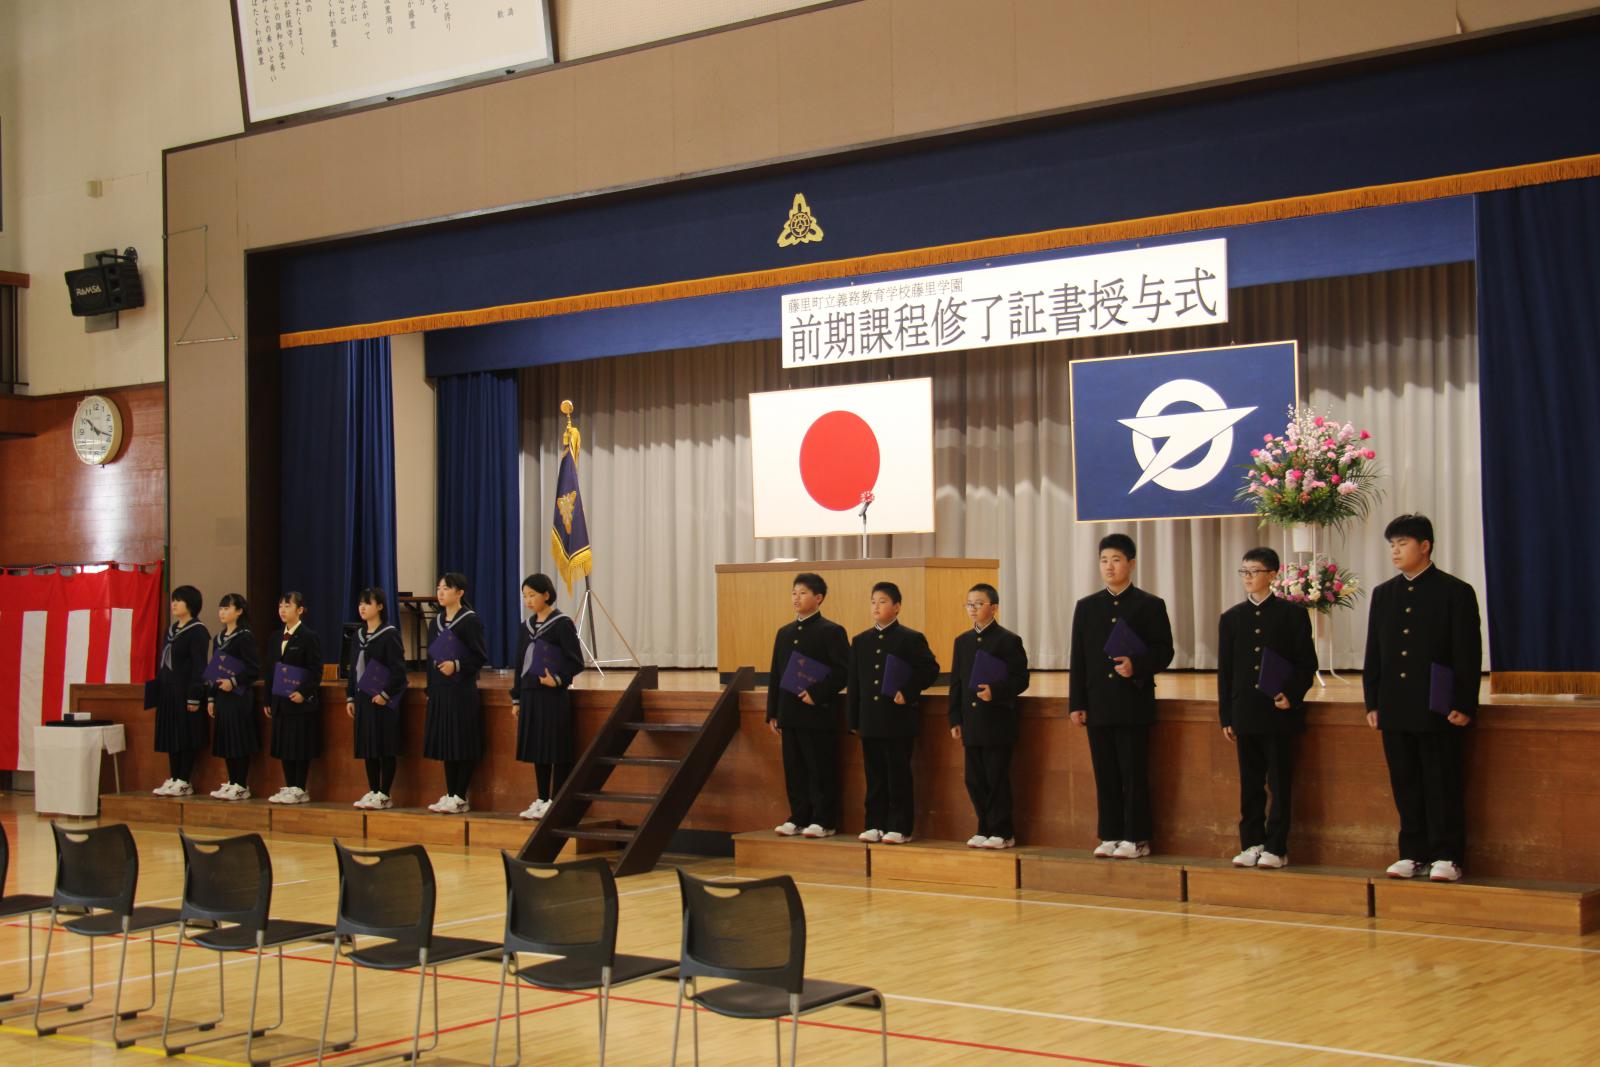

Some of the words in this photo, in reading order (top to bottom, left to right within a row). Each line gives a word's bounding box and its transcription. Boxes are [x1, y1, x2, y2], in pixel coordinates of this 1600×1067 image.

[75, 284, 102, 297] RAMSA
[788, 277, 963, 314] 藤里町立義務教育学校藤里学園
[790, 267, 1217, 363] 前期課程修了証書授与式
